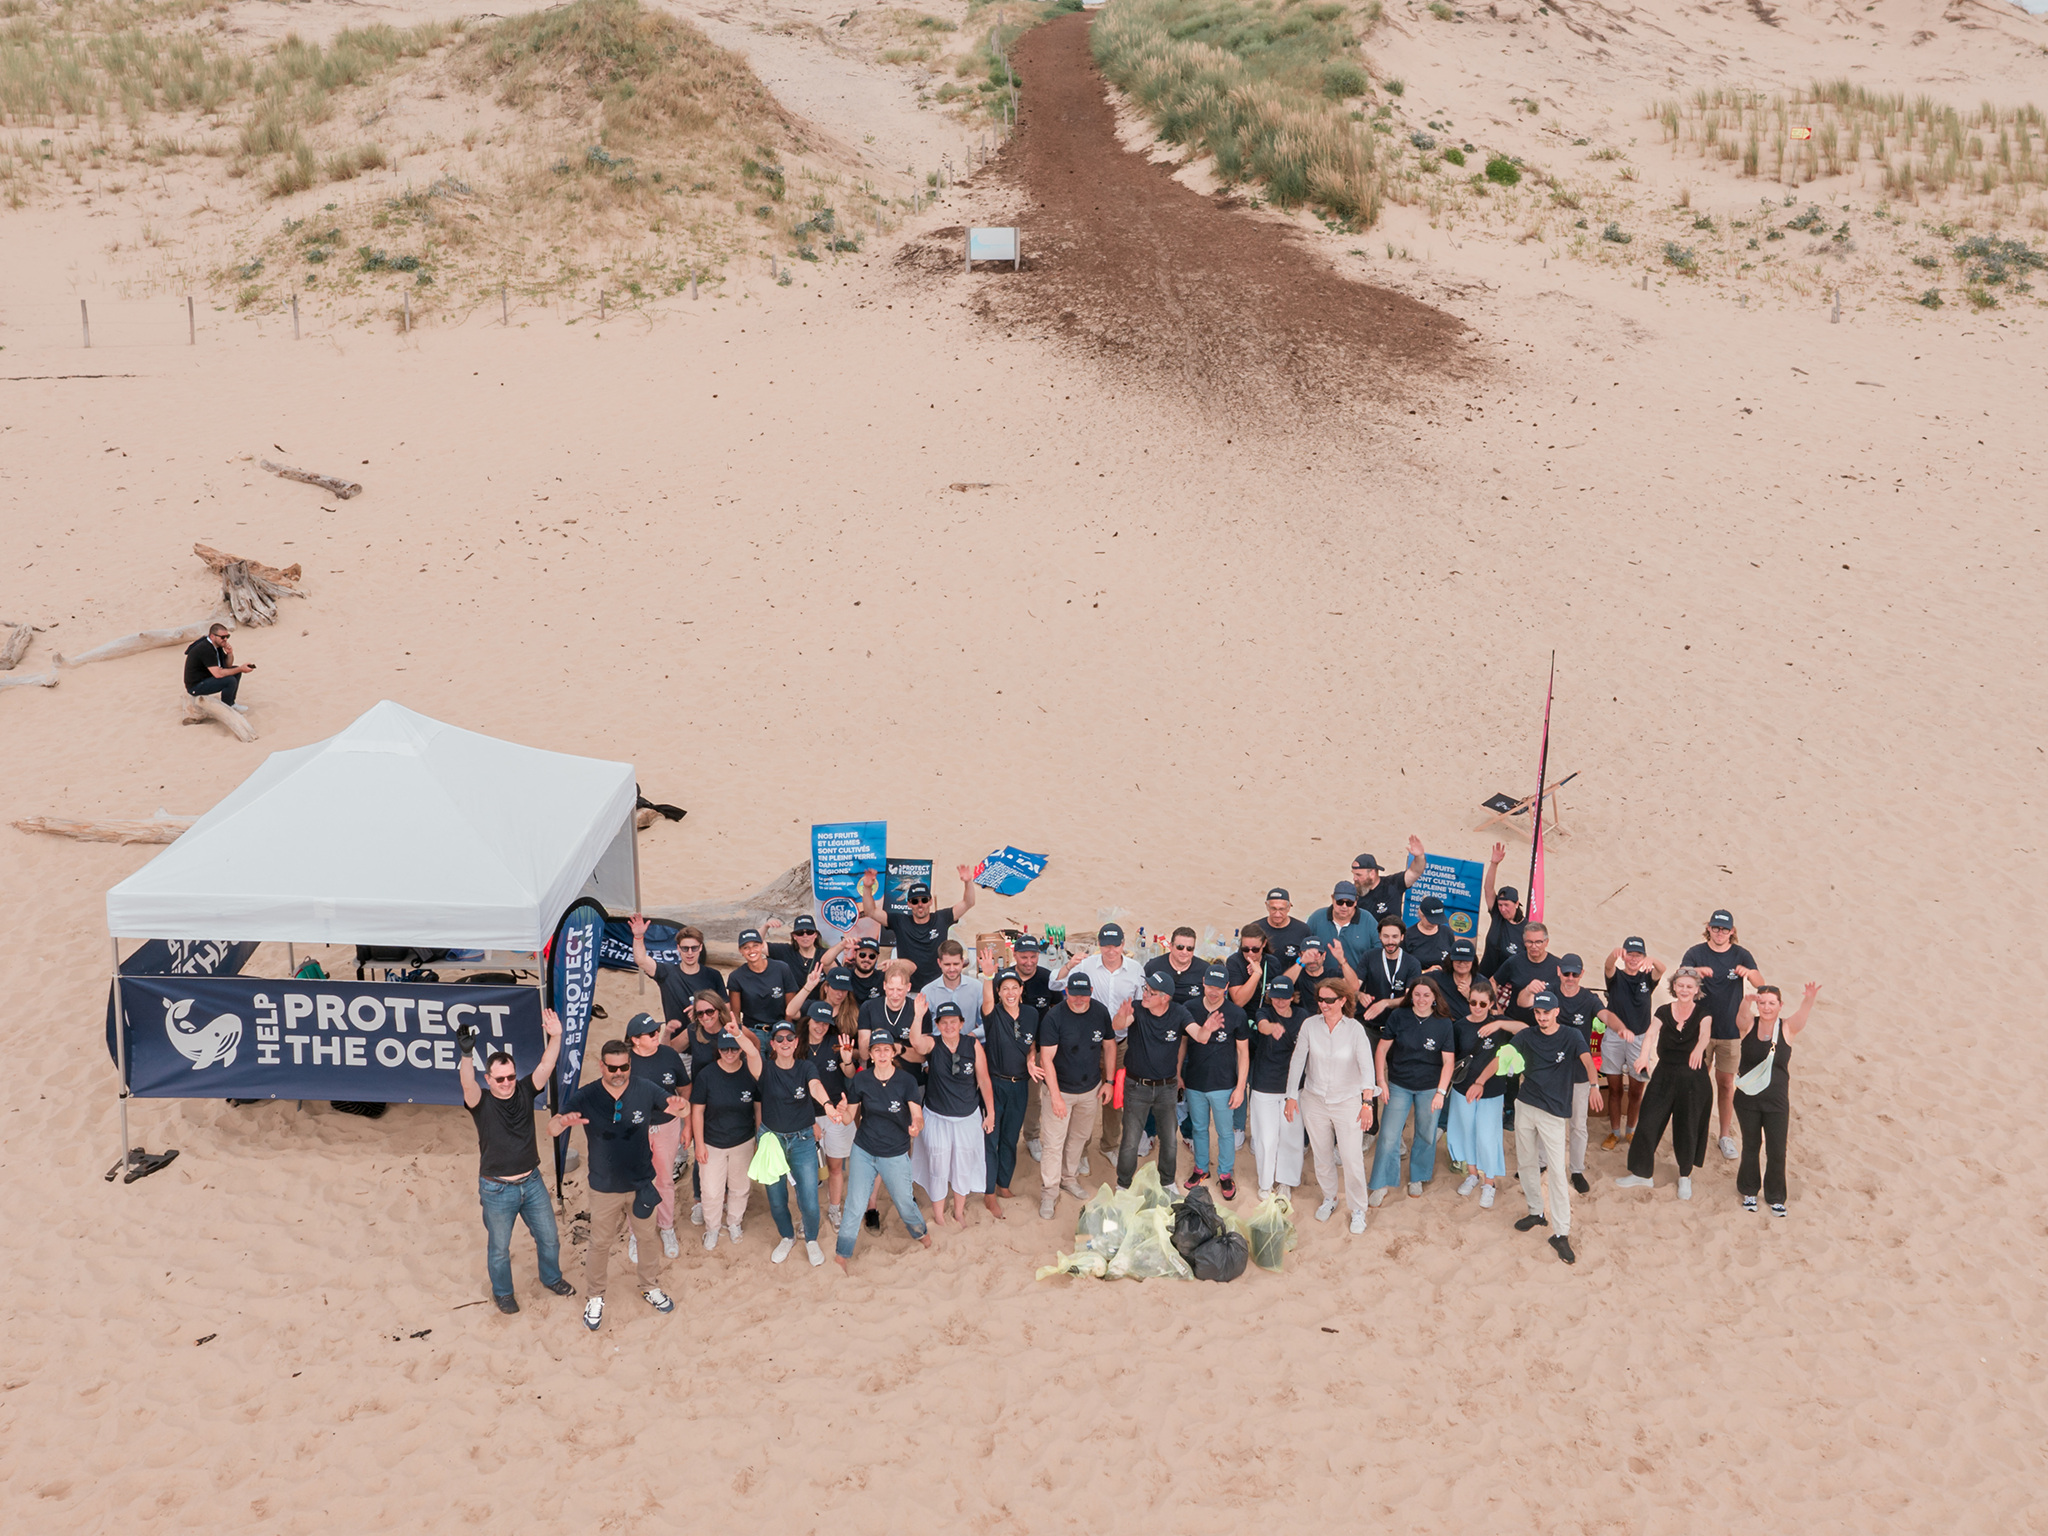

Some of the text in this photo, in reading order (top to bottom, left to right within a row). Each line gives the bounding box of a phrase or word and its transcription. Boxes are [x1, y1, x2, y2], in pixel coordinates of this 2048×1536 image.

[838, 845, 870, 853] CULTIVÉS
[1430, 863, 1455, 873] FRUITS
[1418, 875, 1466, 889] ONT CULTIVÉS
[1423, 883, 1447, 892] PLEINE
[1411, 888, 1447, 900] DANS NOS
[582, 923, 593, 988] OCEAN
[565, 926, 584, 1032] PROTECT
[284, 993, 511, 1037] PROTECT
[253, 993, 280, 1064] HELP
[284, 1035, 368, 1066] THE
